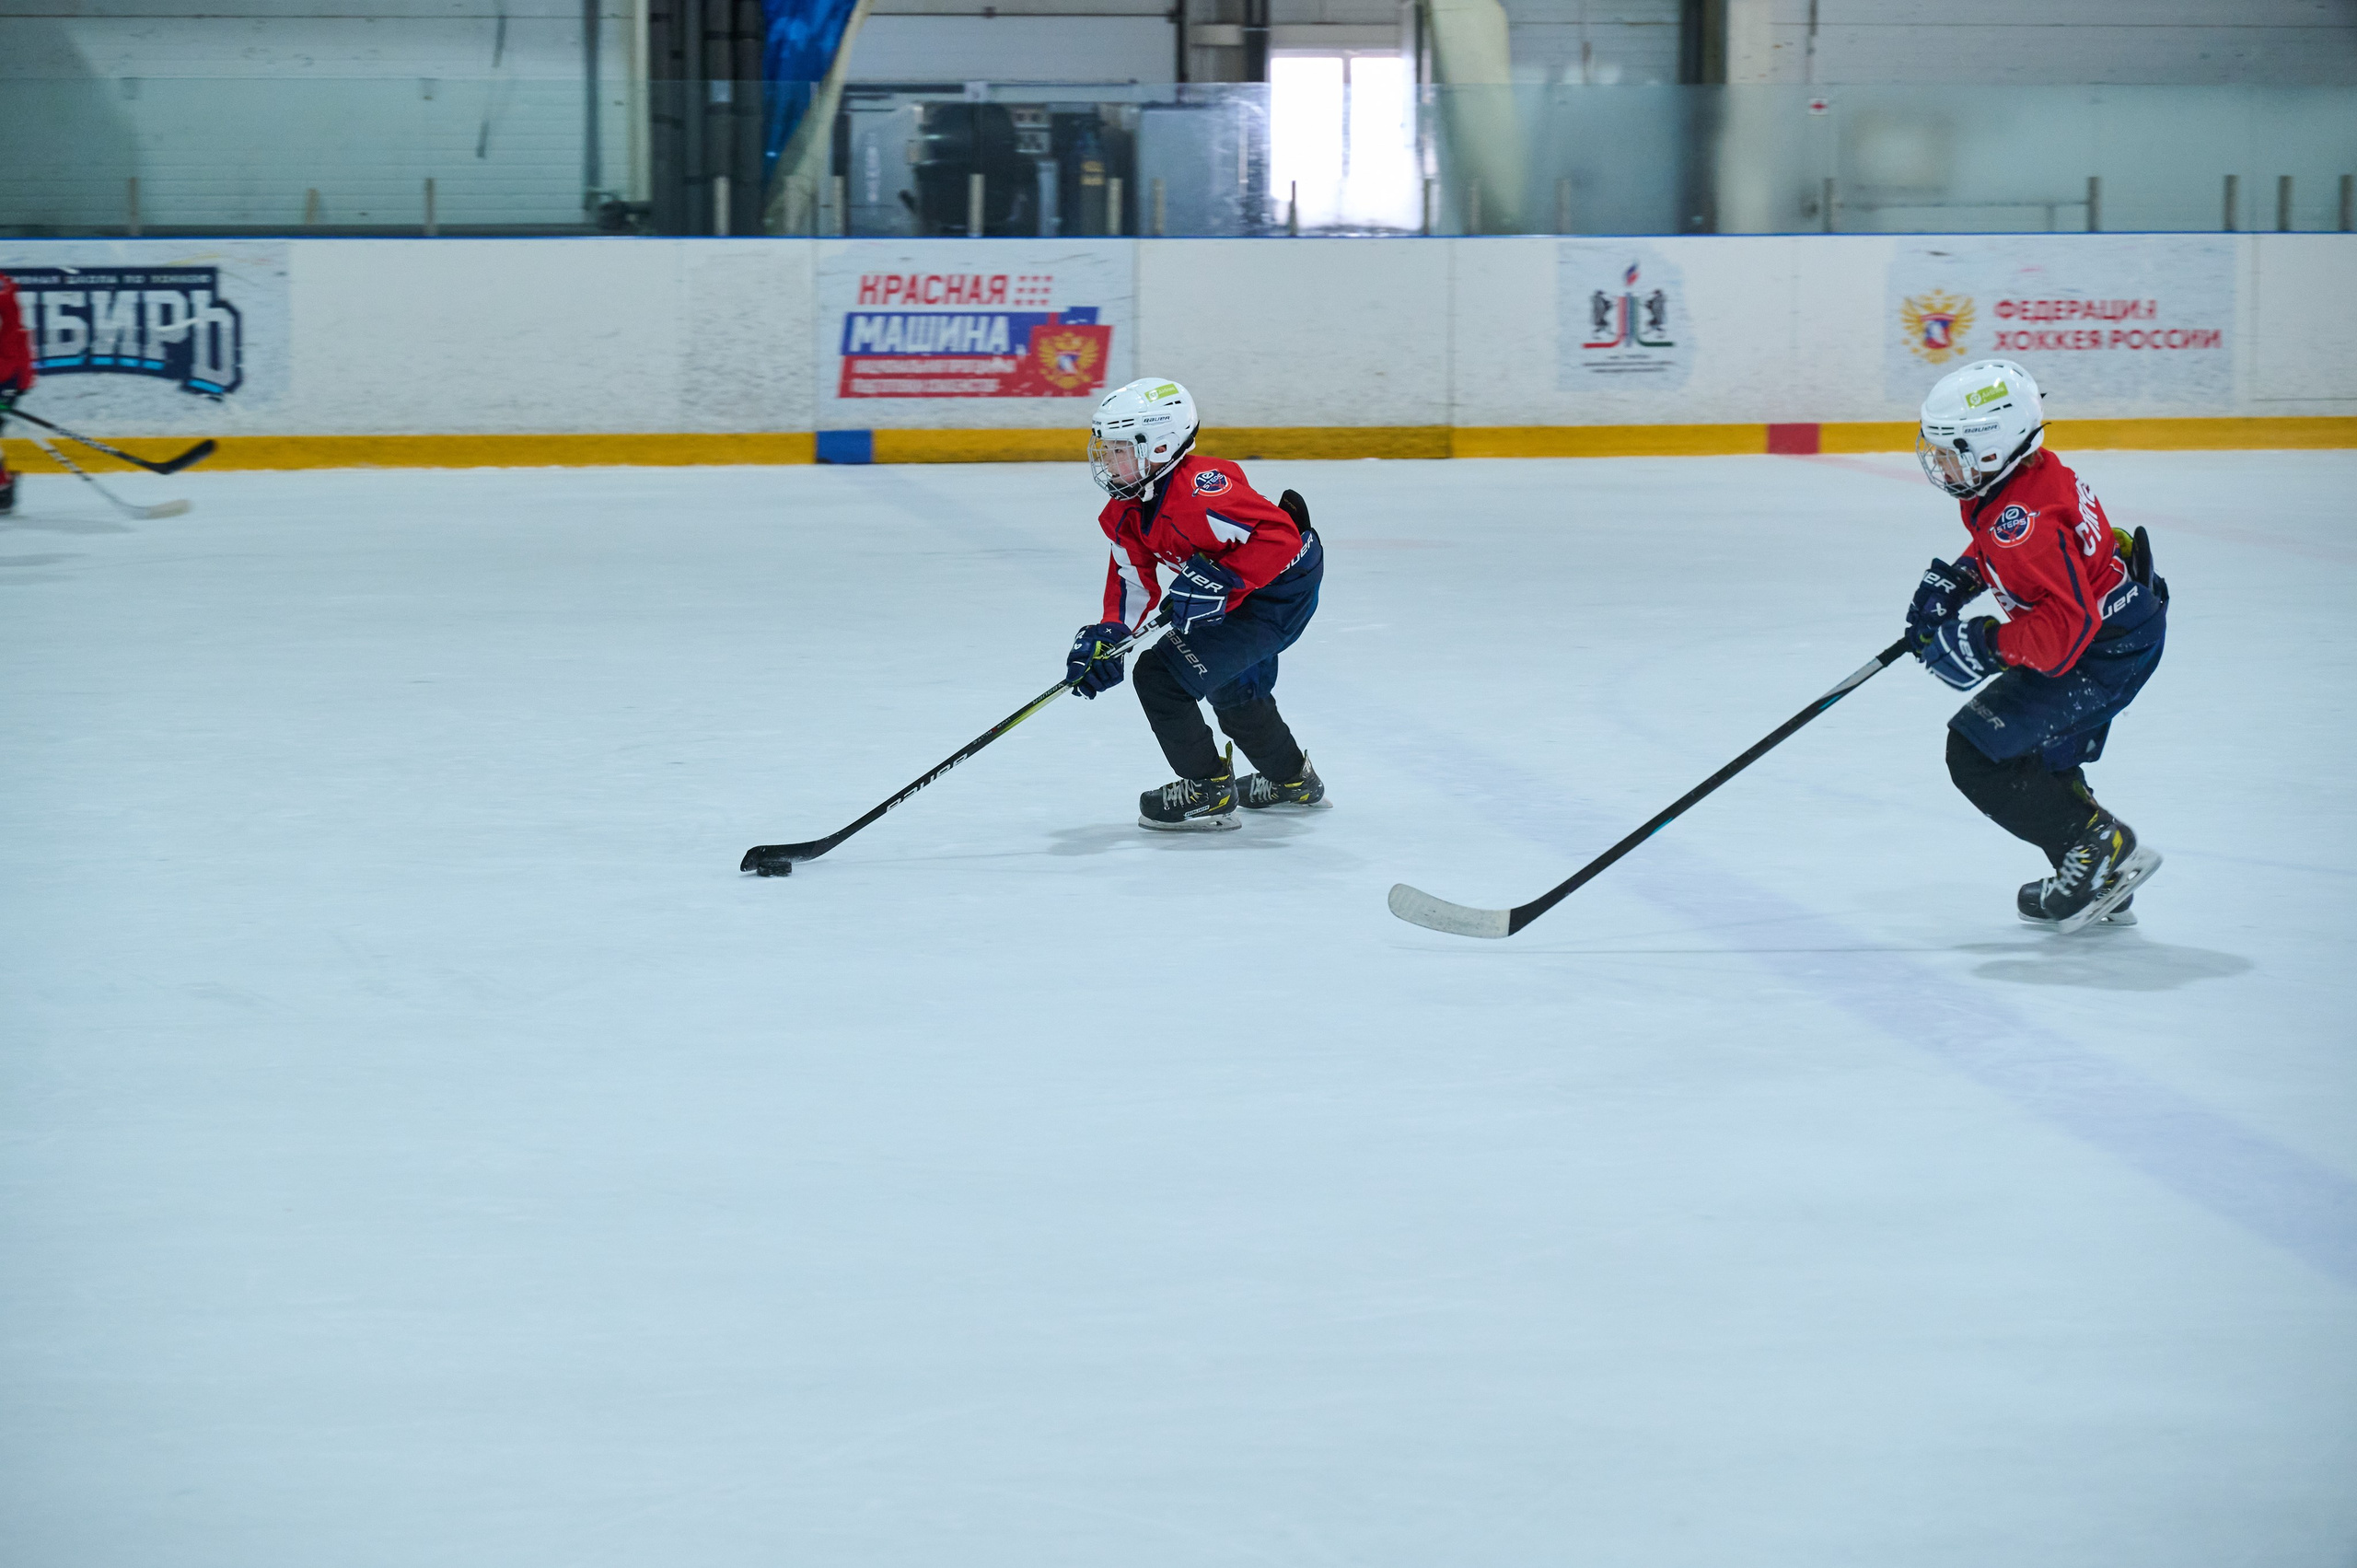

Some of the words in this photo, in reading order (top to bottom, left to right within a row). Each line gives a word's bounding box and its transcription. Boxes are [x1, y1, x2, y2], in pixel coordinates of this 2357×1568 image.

[857, 274, 1009, 305] КРАСНАЯ
[18, 289, 235, 387] БИРЬ
[849, 316, 1011, 353] МАШИНА
[1991, 330, 2103, 351] ХОККЕЯ
[2107, 329, 2223, 350] РОССИИ
[1964, 424, 1999, 435] BAUER
[1197, 471, 1214, 482] 10
[1202, 472, 1224, 490] STEPS
[1996, 517, 2027, 534] STEPS
[2001, 507, 2020, 523] 10
[1182, 564, 1224, 594] UER
[2101, 585, 2139, 621] UER
[1166, 629, 1208, 680] BAUER
[1957, 621, 1985, 672] UER
